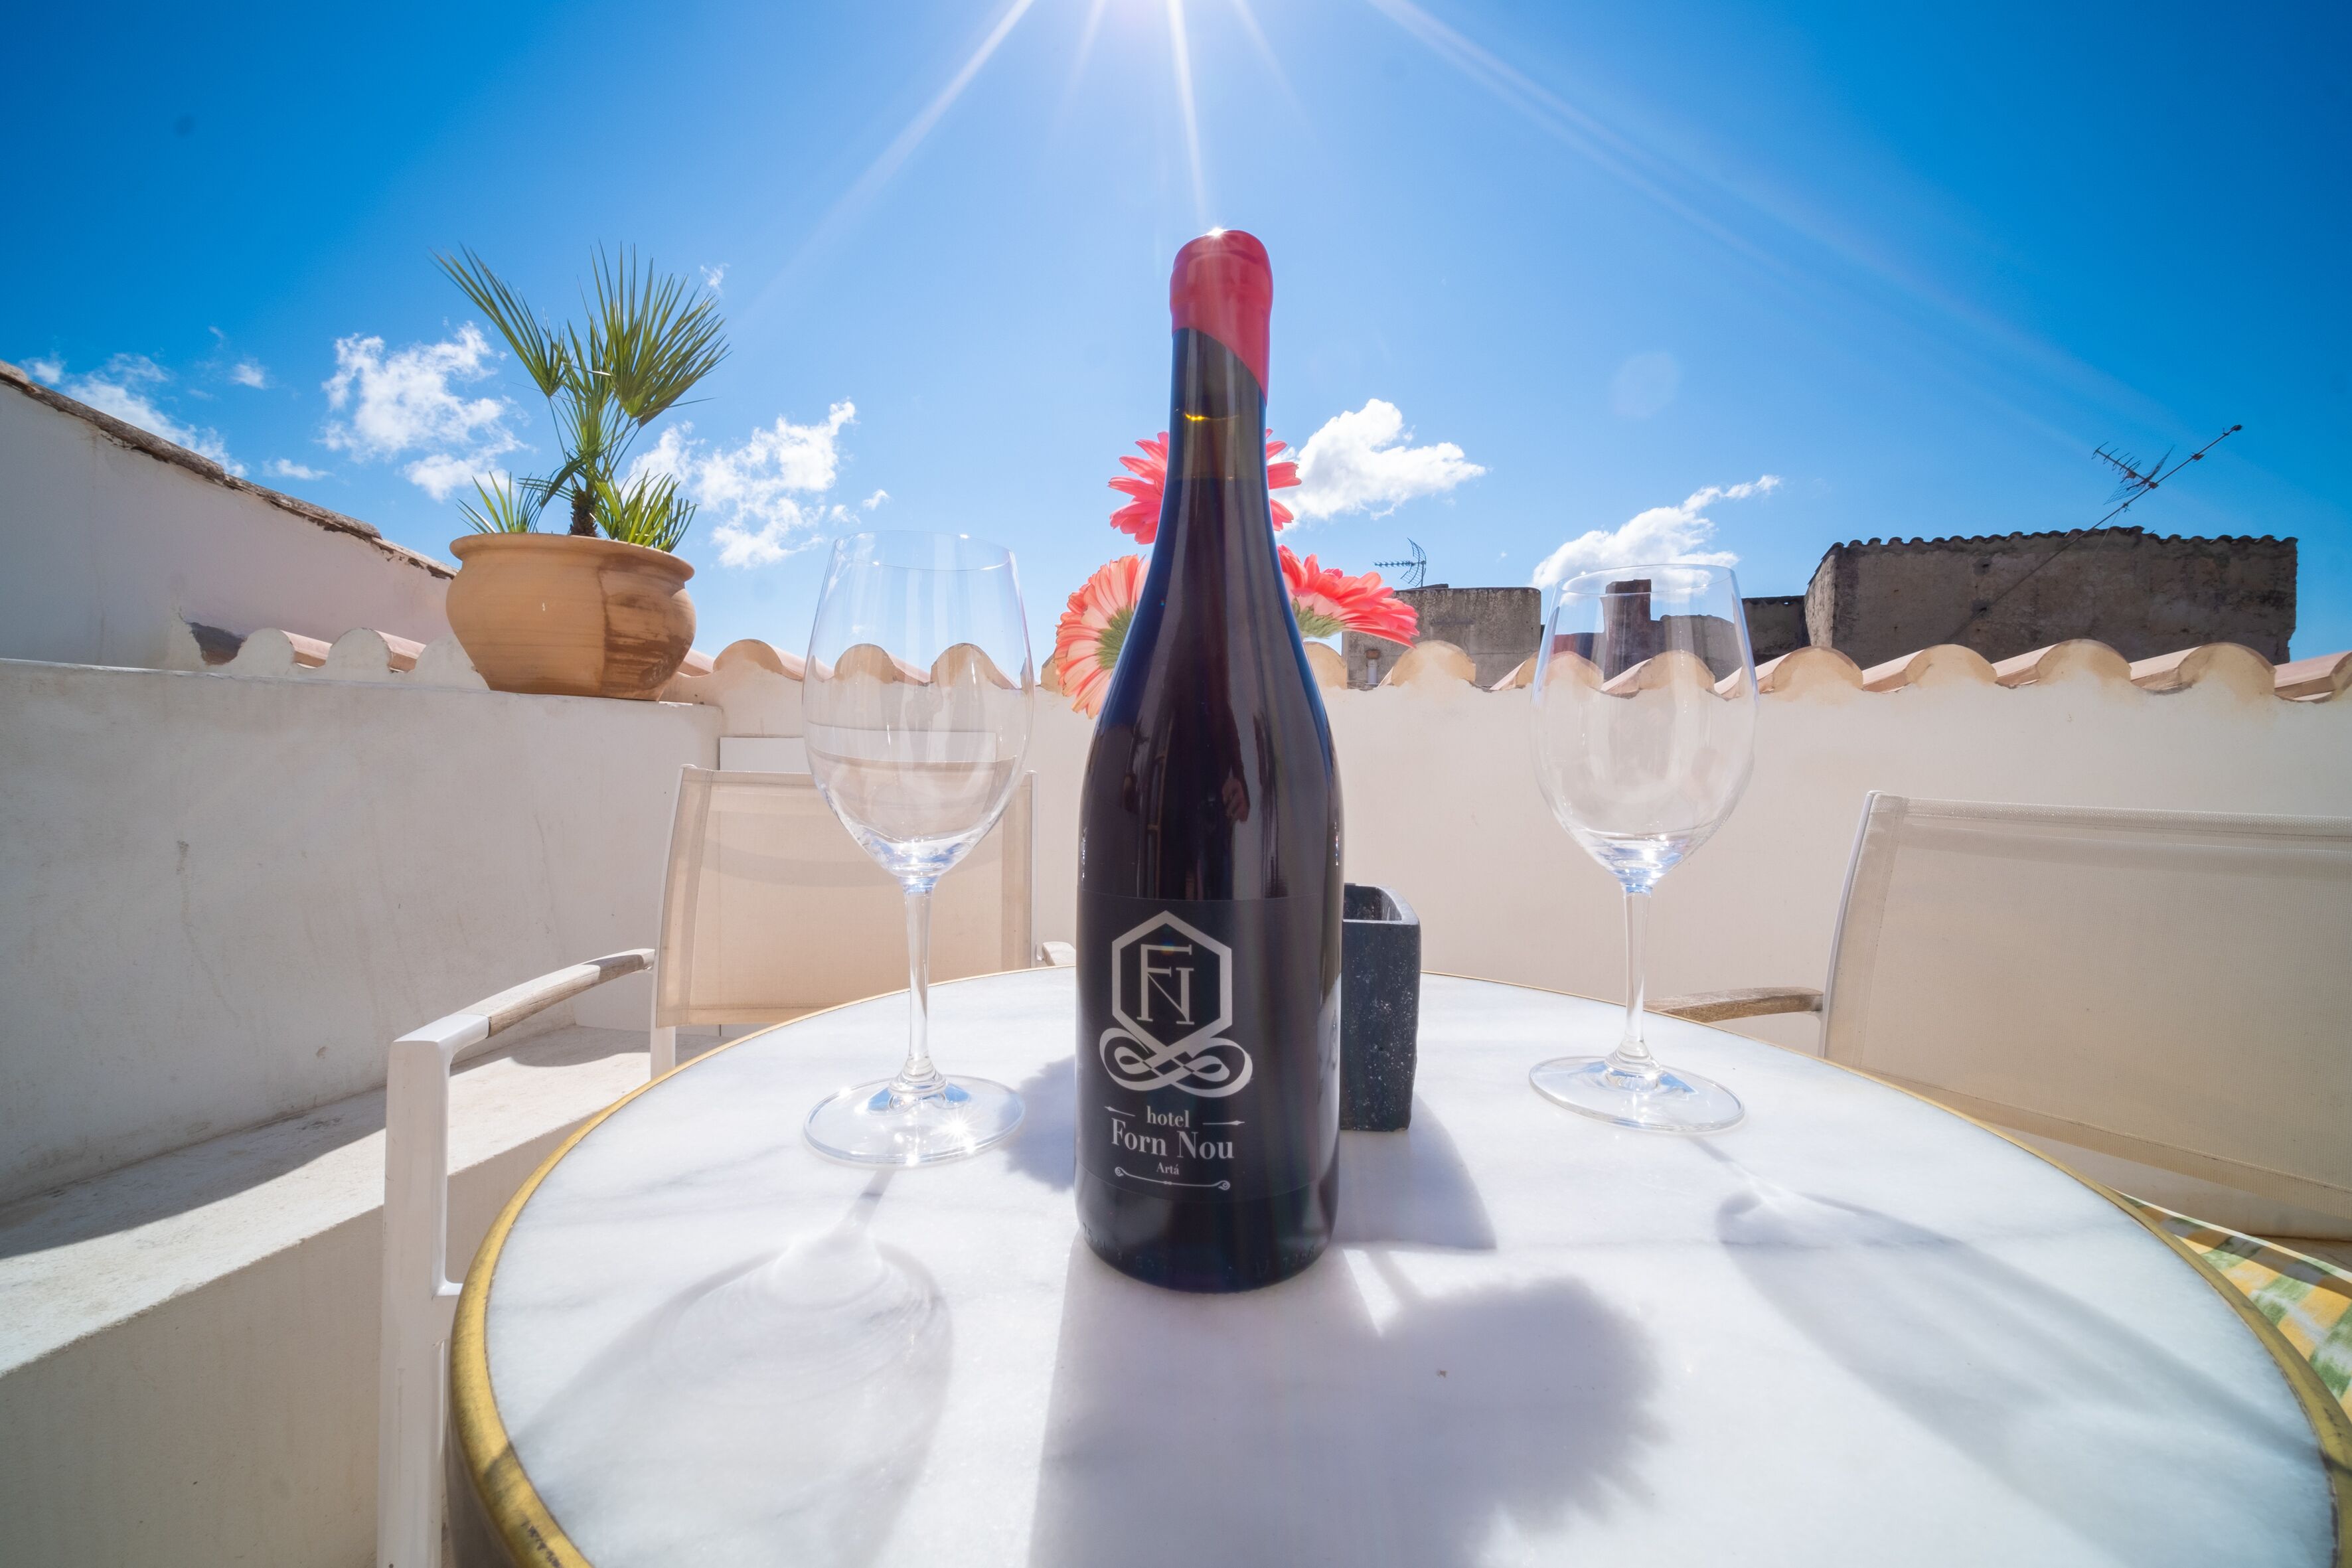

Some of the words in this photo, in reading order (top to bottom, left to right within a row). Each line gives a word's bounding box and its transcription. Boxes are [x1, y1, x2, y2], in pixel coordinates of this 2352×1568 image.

[1146, 1105, 1190, 1128] hotel
[1111, 1117, 1166, 1156] Forn
[1177, 1131, 1234, 1160] Nou
[1156, 1162, 1179, 1176] Artá
